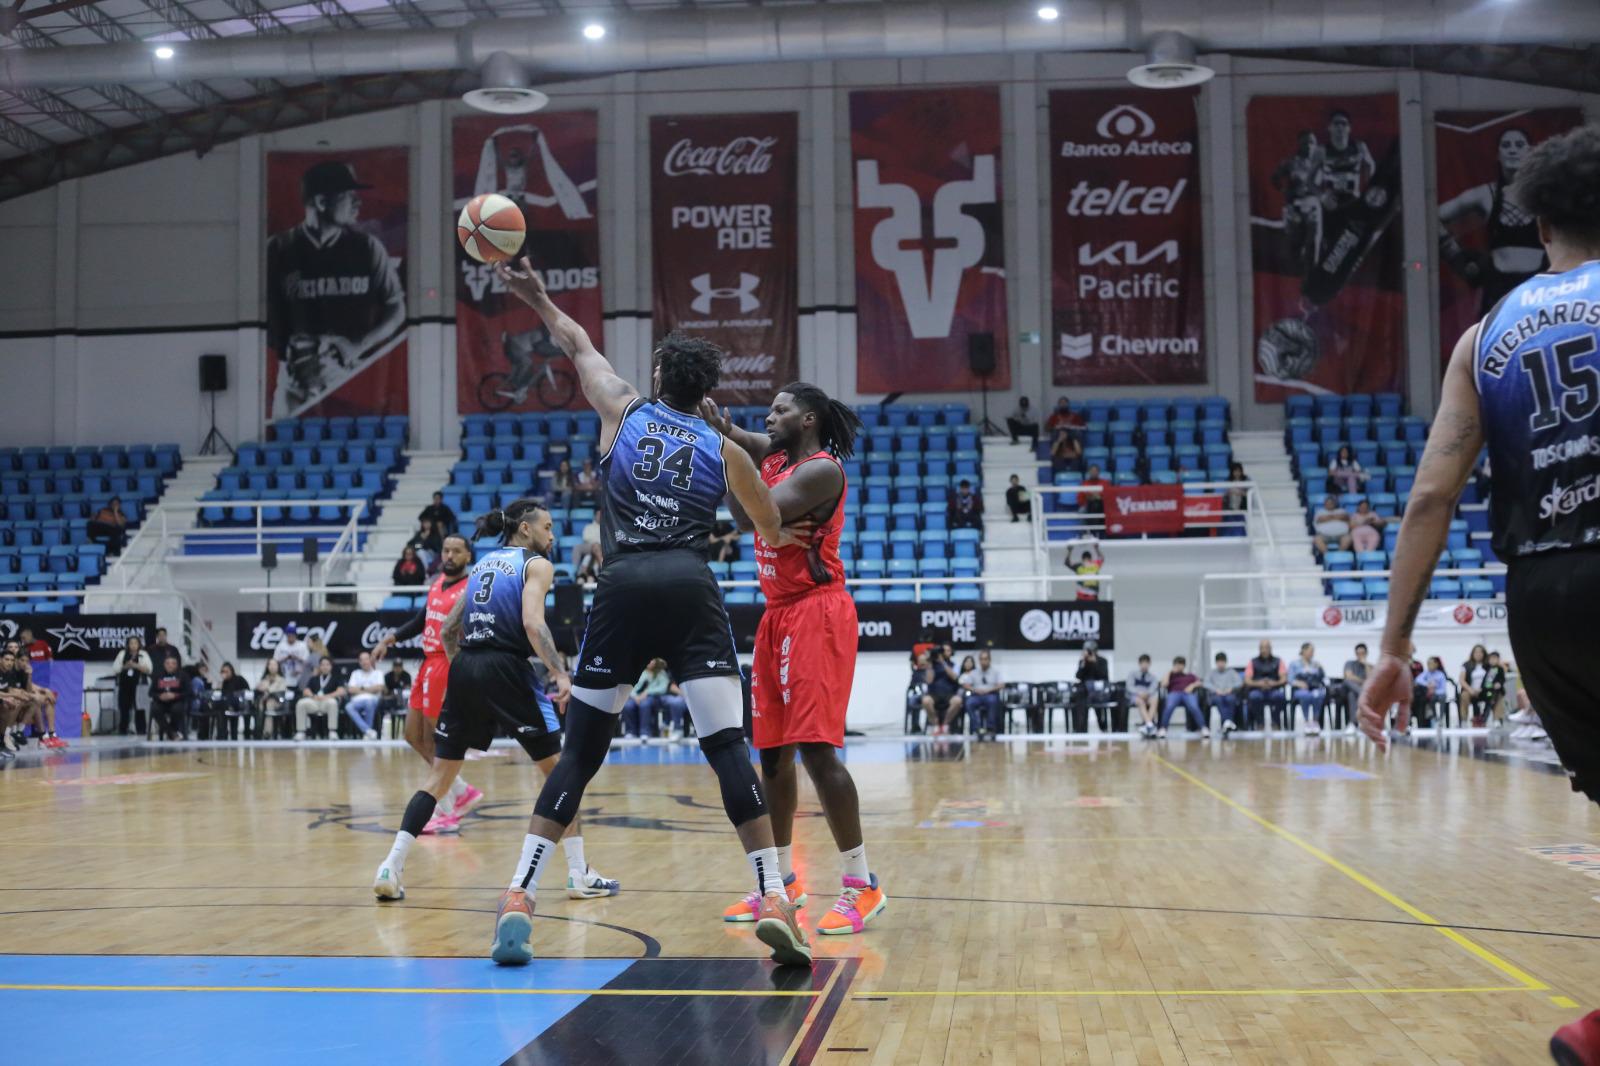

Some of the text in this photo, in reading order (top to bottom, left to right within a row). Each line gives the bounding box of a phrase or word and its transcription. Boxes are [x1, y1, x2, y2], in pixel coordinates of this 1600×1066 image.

[663, 135, 778, 176] Coca-Cola
[1061, 140, 1193, 158] Banco Azteca
[1066, 177, 1188, 217] telcel
[672, 204, 773, 229] POWER
[717, 227, 774, 250] ADE
[1079, 272, 1179, 300] Pacific
[1520, 274, 1591, 306] Mobil
[1100, 334, 1199, 356] Chevron
[1521, 333, 1600, 432] 15
[646, 421, 699, 445] BATES
[632, 436, 695, 491] 34
[635, 489, 680, 512] TOSCANAS
[474, 570, 497, 605] 3
[84, 627, 146, 639] AMERICAN
[1052, 610, 1101, 633] UAD
